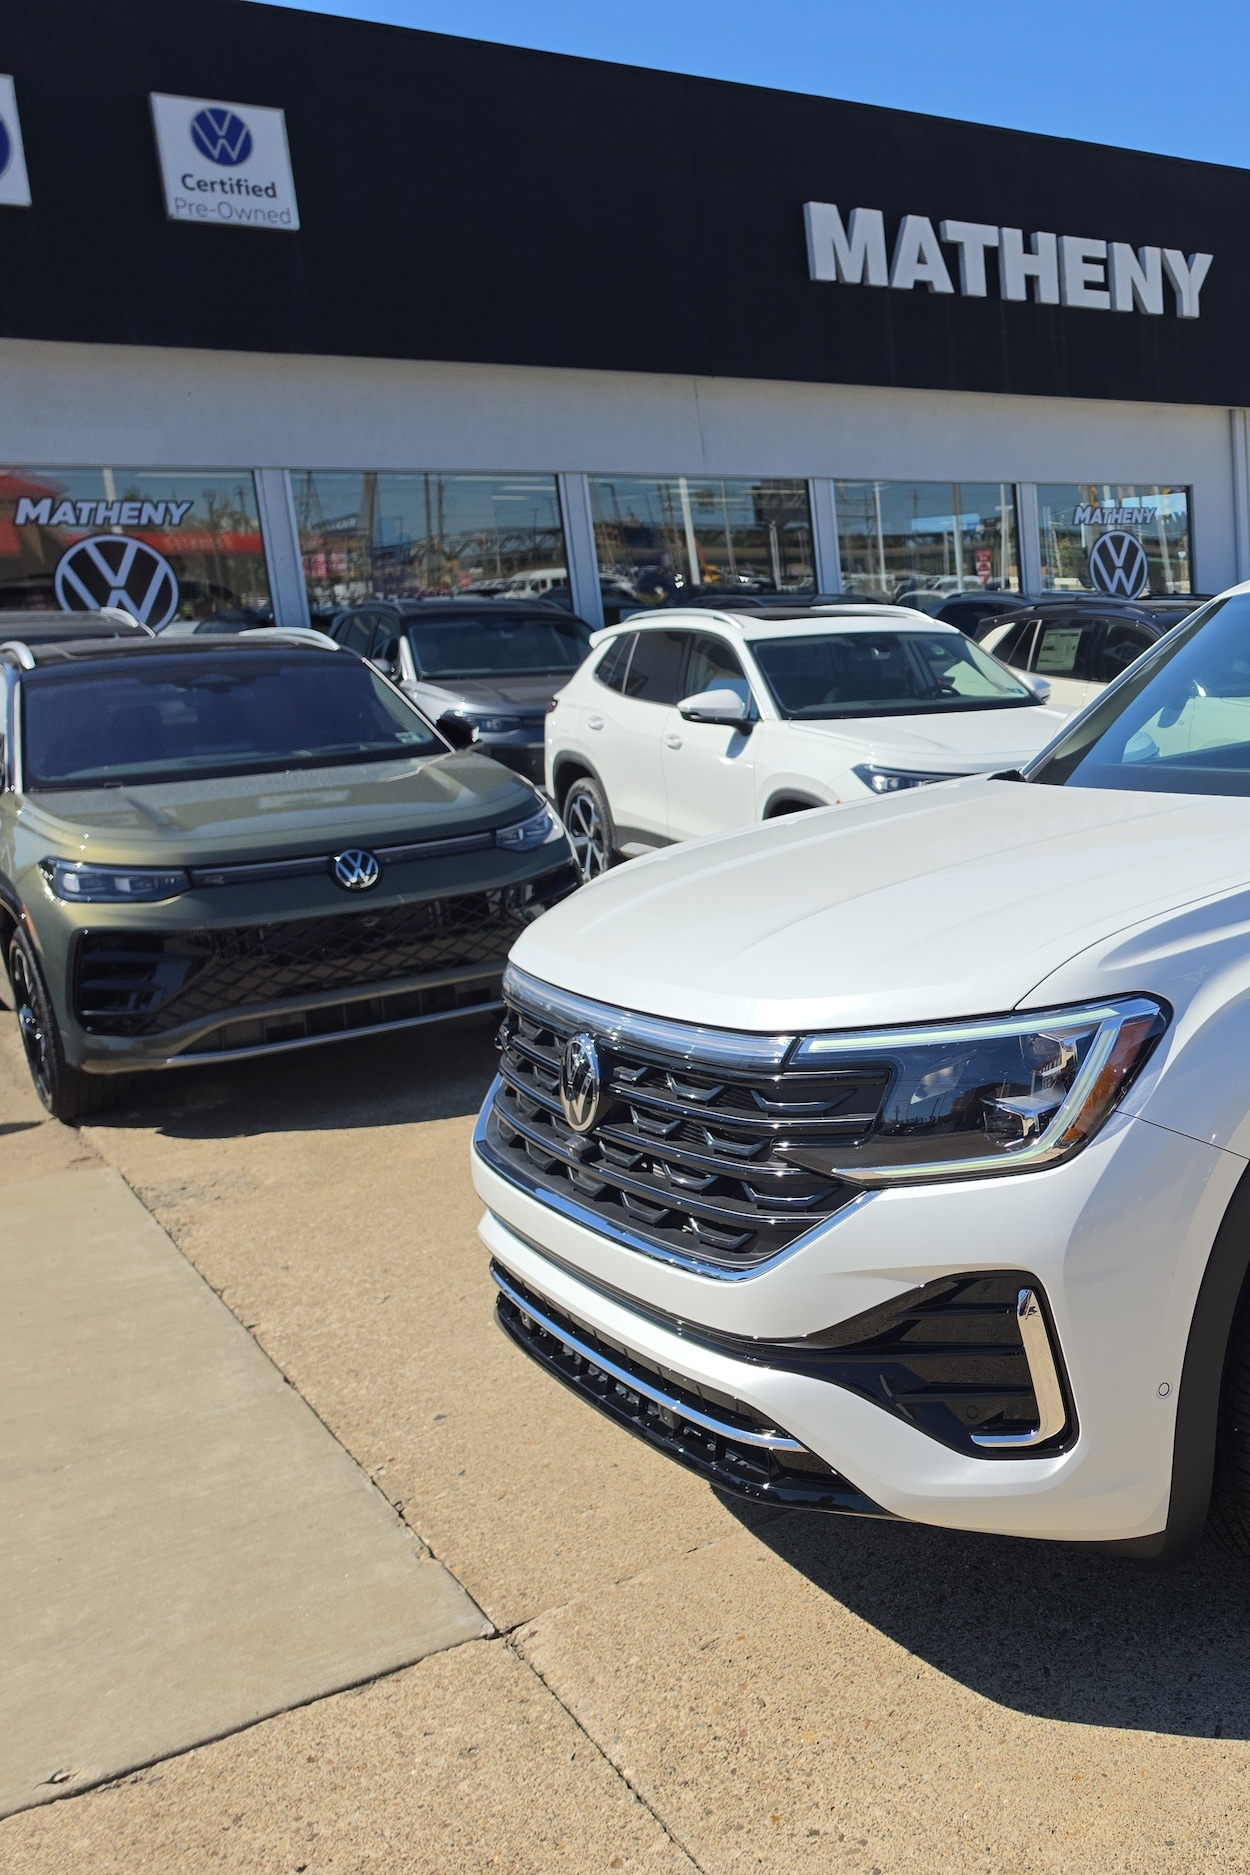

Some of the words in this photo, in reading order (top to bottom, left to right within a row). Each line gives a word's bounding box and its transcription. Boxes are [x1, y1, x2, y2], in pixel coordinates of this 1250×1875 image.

[181, 174, 277, 198] Certified
[174, 197, 292, 225] Pre-Owned
[803, 201, 1213, 319] MATHENY
[14, 497, 194, 527] MATHENY
[1074, 505, 1157, 525] MATHENY
